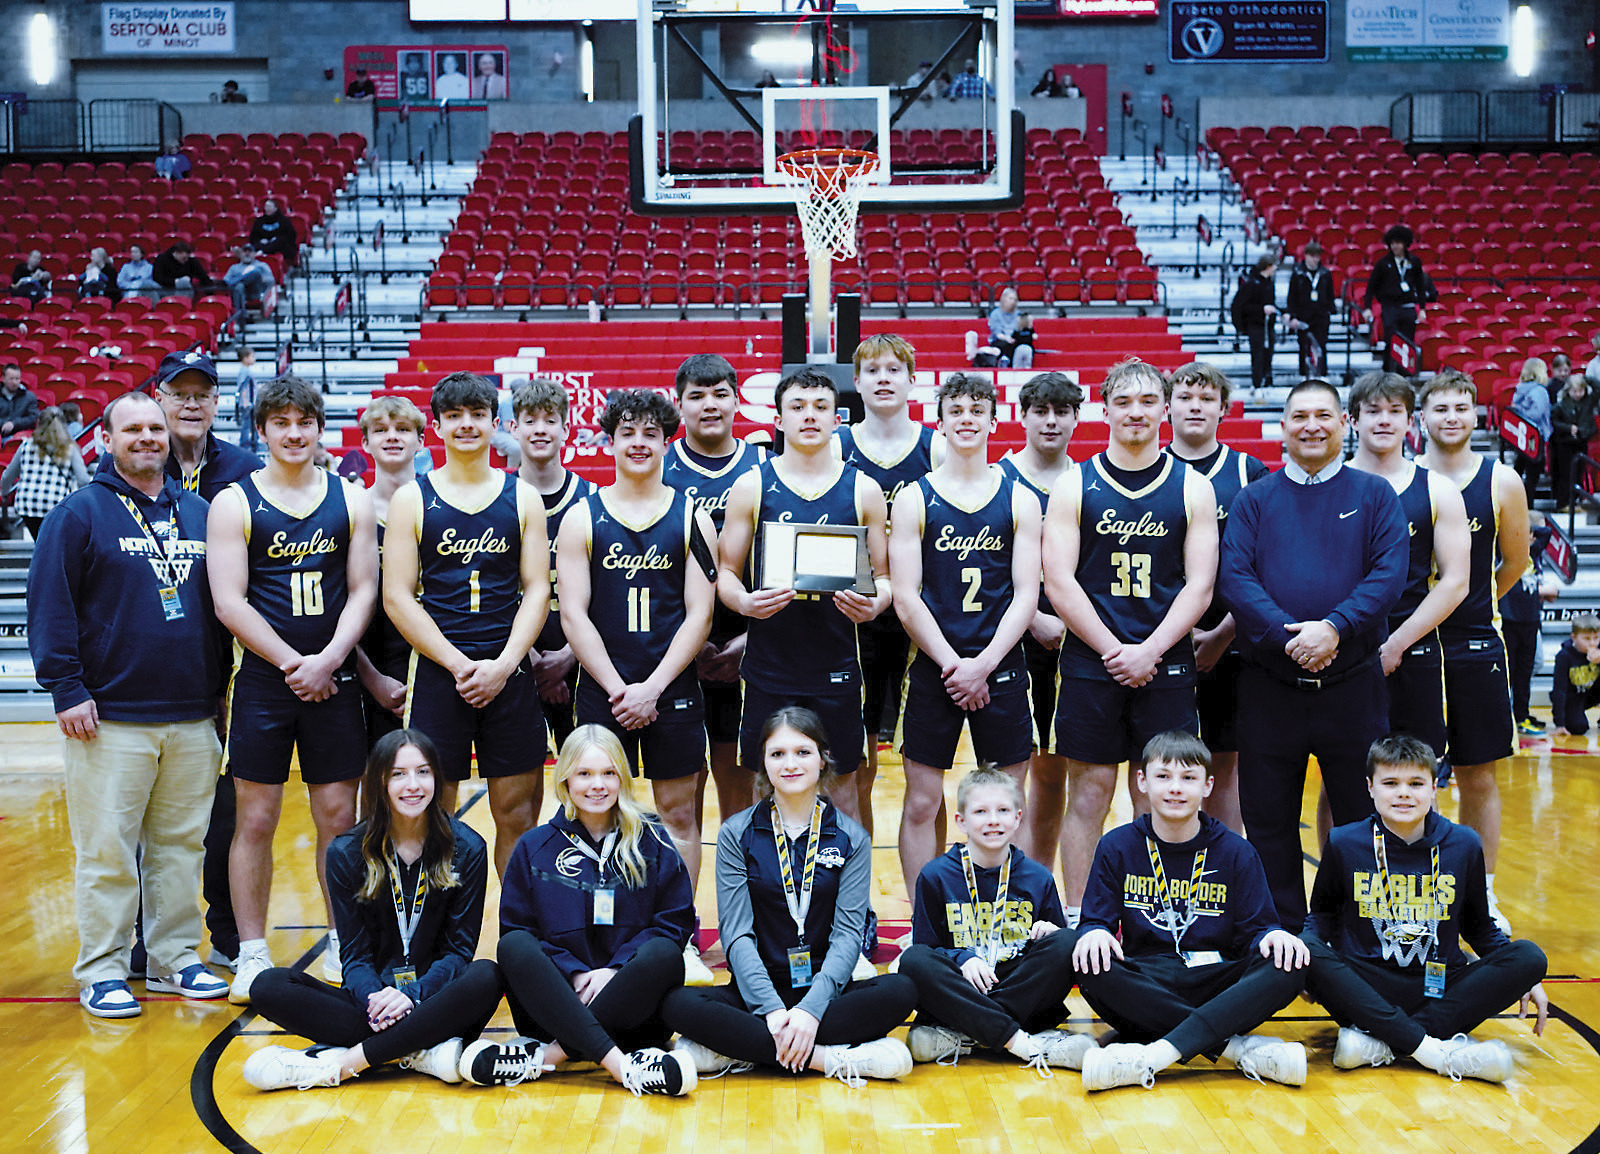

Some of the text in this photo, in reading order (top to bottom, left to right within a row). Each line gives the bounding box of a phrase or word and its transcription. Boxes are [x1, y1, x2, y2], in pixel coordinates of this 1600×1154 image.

[109, 7, 226, 21] Flag Display Donated By
[1176, 4, 1323, 15] Vibeto Orthodontics
[110, 23, 226, 36] SERTOMA CLUB
[137, 39, 199, 47] OF MINOT
[406, 77, 427, 95] 56
[656, 192, 691, 200] SPALDING
[935, 524, 1004, 561] Eagles
[1095, 508, 1168, 545] Eagles
[267, 528, 338, 566] Eagles
[436, 527, 510, 564] Eagles
[602, 542, 672, 580] Eagles
[290, 571, 325, 616] 10
[469, 570, 480, 613] 1
[961, 567, 982, 612] 2
[1110, 552, 1151, 598] 33
[627, 587, 650, 632] 11
[1170, 879, 1227, 903] BODER
[1353, 871, 1456, 905] EAGLES
[945, 900, 1034, 933] EAGES
